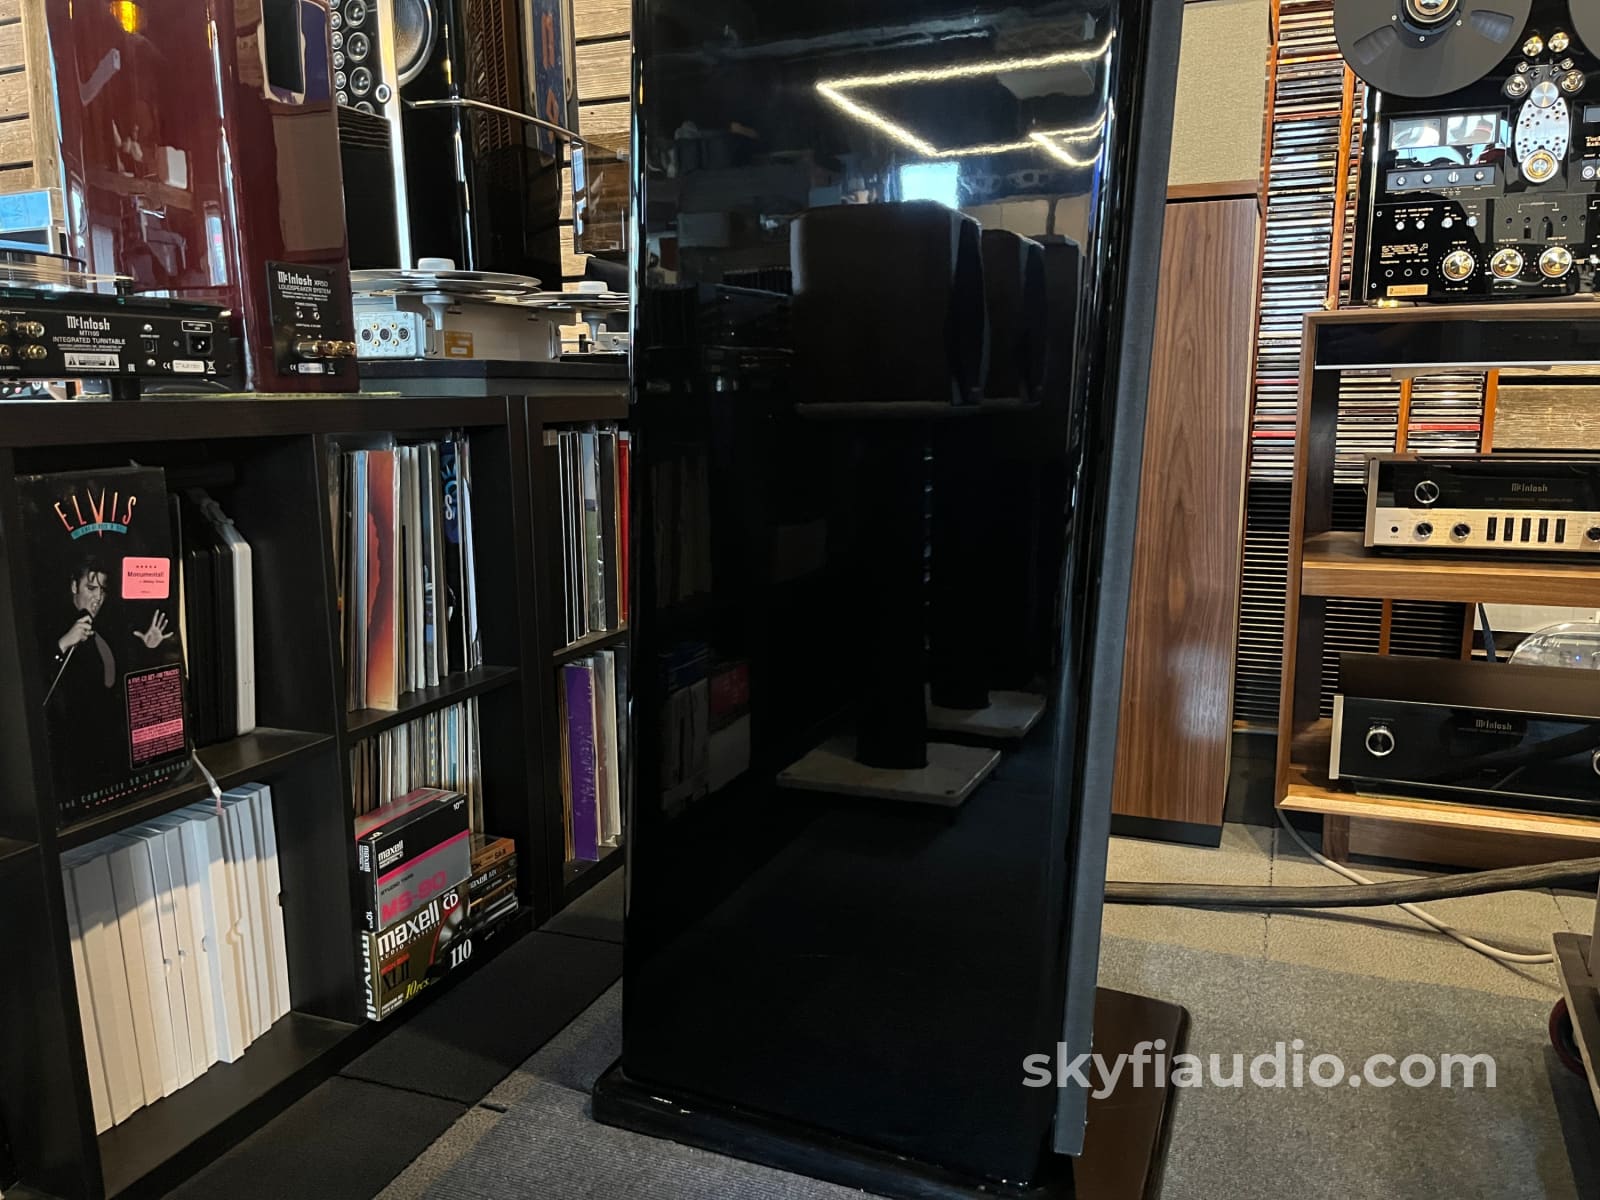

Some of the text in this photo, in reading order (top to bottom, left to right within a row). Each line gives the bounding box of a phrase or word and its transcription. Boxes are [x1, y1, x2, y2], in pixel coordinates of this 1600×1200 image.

[278, 271, 312, 287] McIntosh
[66, 315, 110, 331] McIntosh
[52, 336, 126, 345] INTEGRATED TURNTABLE
[1512, 483, 1548, 492] McIntosh
[54, 487, 137, 538] ELVIS
[378, 840, 403, 861] maxell
[377, 899, 440, 956] maxell
[450, 938, 473, 969] 110
